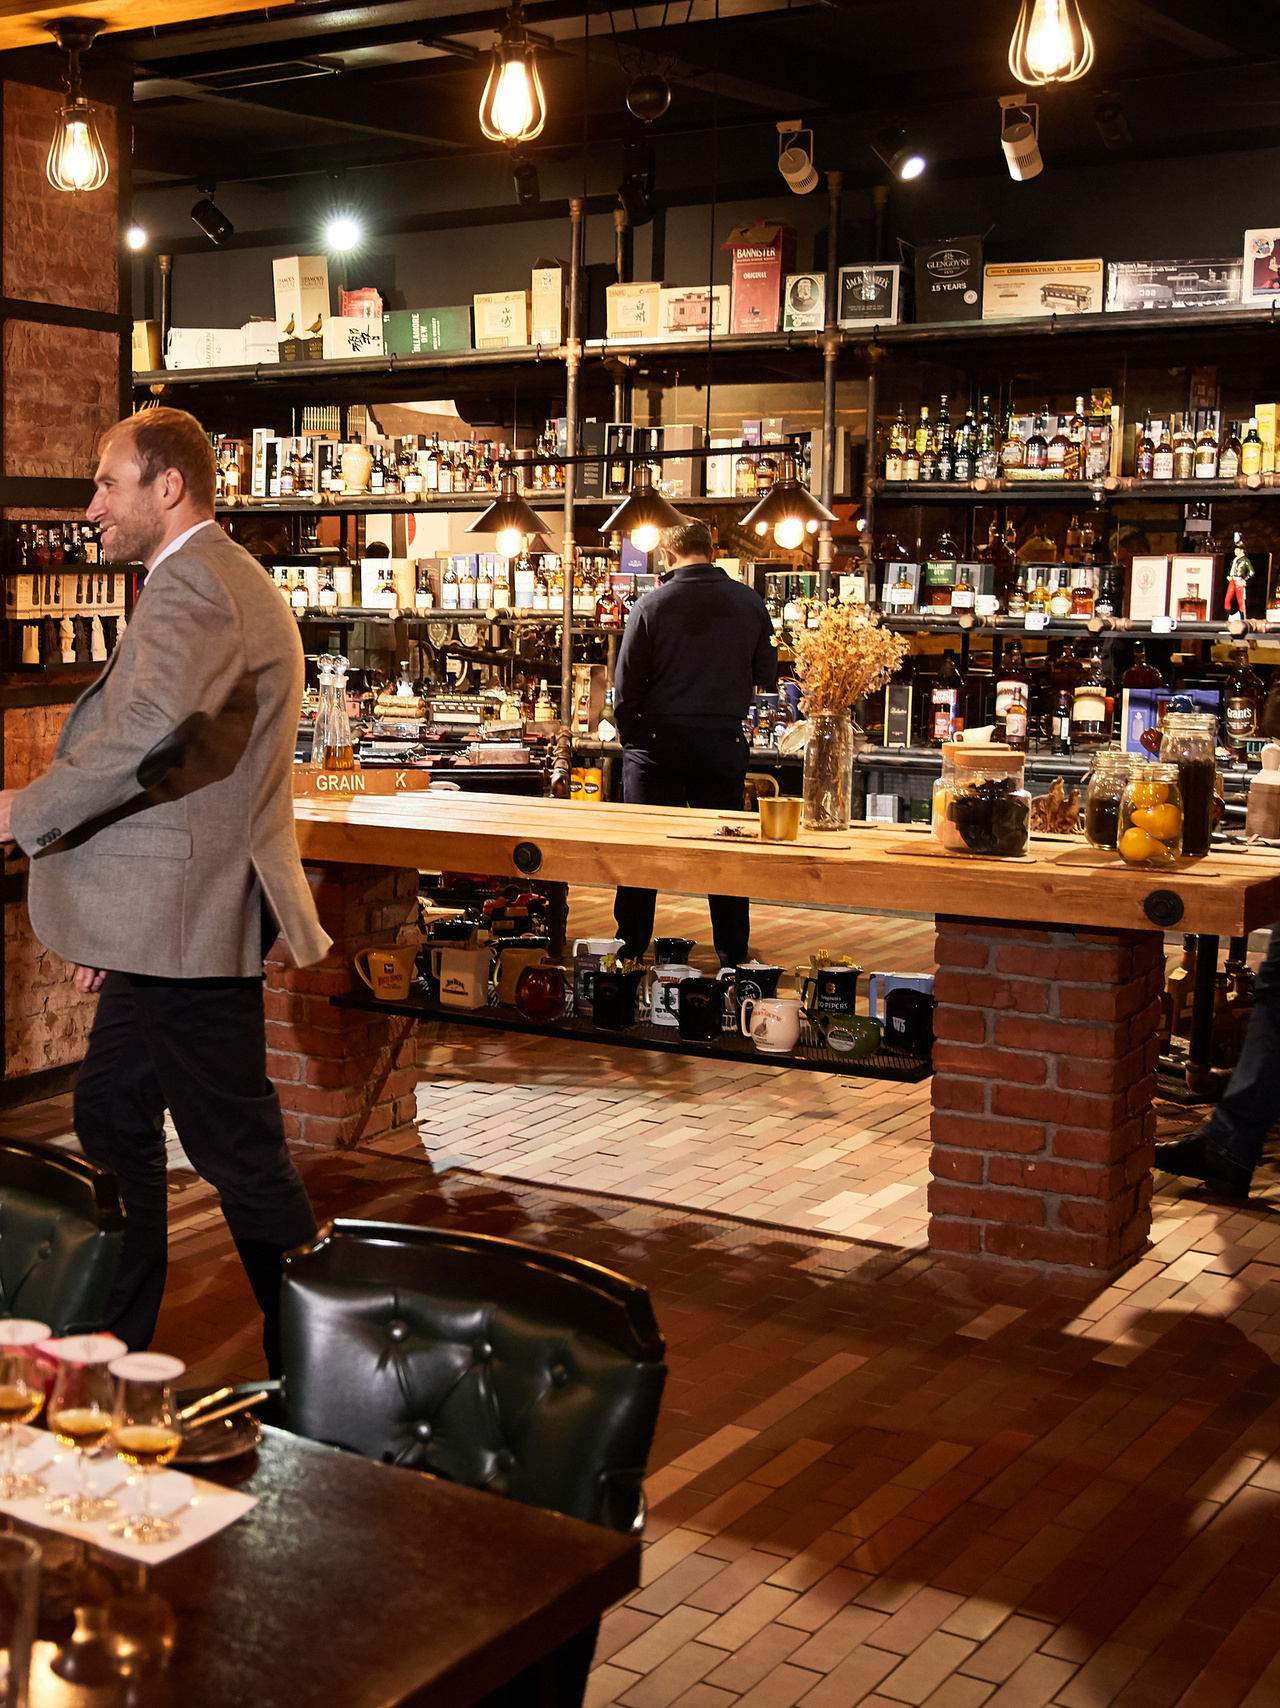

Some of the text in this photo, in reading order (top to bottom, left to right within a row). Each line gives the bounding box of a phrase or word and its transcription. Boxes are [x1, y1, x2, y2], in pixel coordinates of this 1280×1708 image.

[736, 247, 776, 258] BANNISTER
[926, 258, 971, 269] GLENGOYNE
[743, 271, 767, 280] ORIGINAL
[845, 274, 862, 290] JACK
[931, 282, 967, 292] 15 YEARS
[411, 313, 420, 354] ULLAMORE
[420, 326, 428, 343] DEW
[926, 562, 953, 570] TULLAMORE
[1226, 706, 1253, 719] Grant's
[316, 774, 366, 791] GRAIN
[825, 1002, 848, 1010] PIPERS
[892, 1016, 906, 1033] W5
